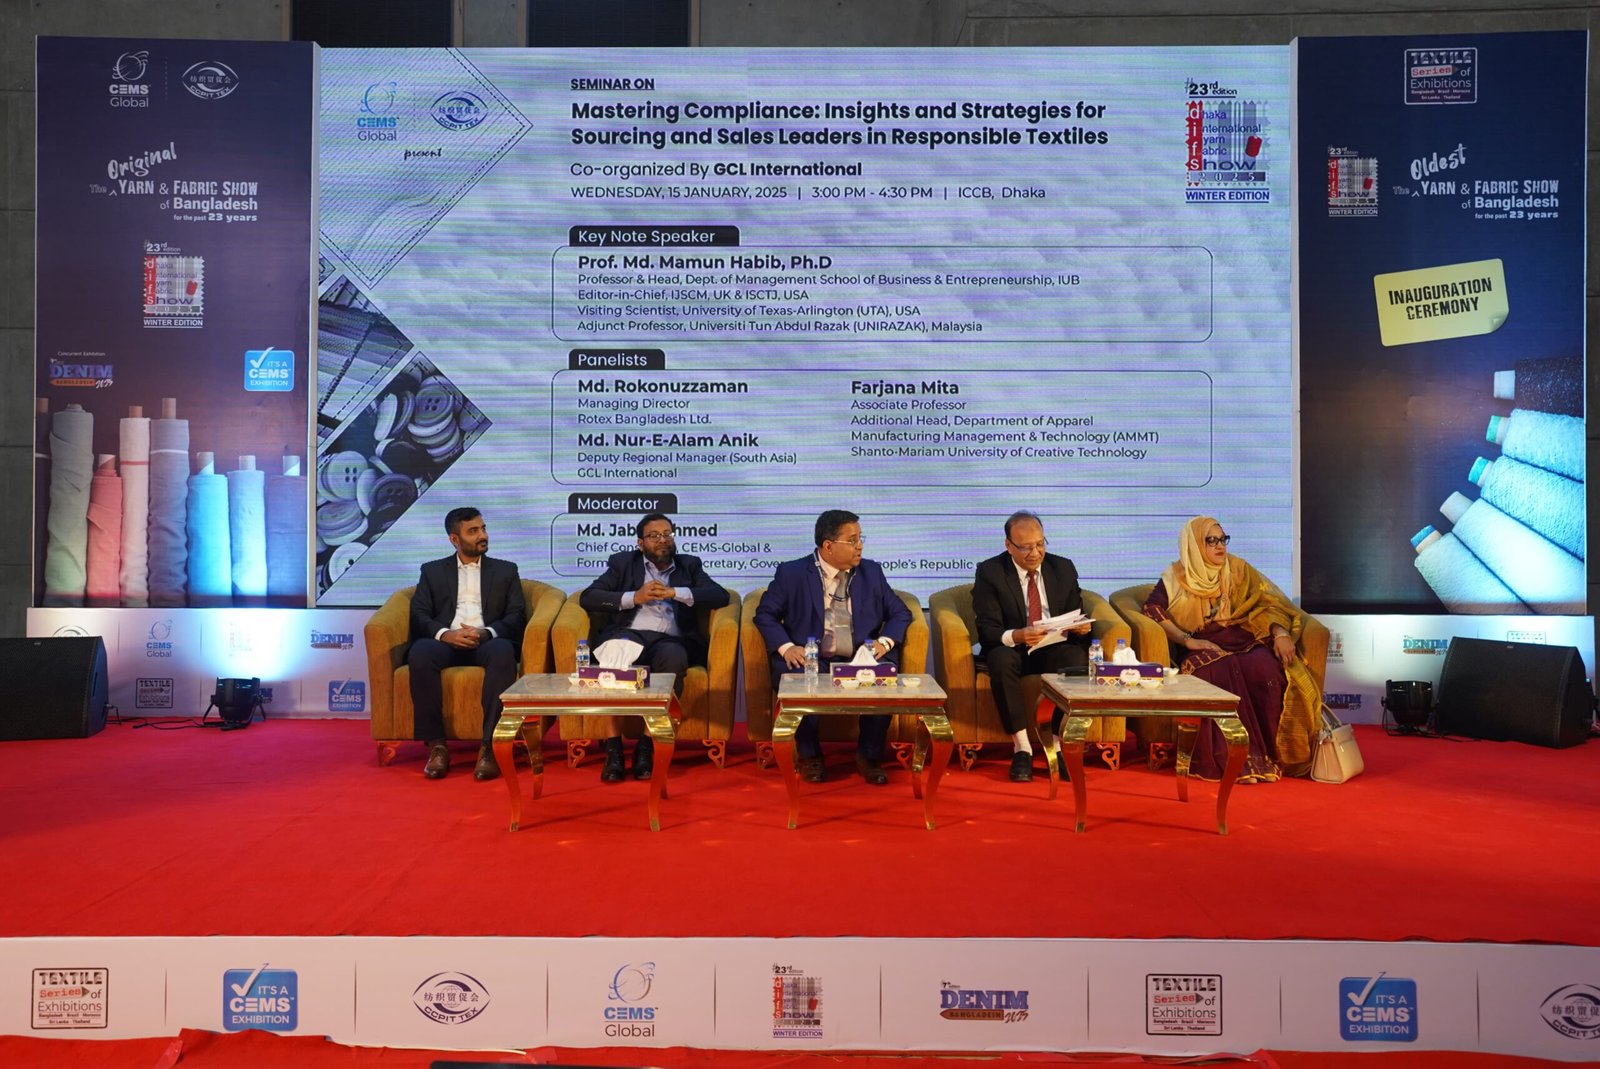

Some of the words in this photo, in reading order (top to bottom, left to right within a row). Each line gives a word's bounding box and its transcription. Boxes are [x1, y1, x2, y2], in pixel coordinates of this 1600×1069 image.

[1410, 51, 1472, 64] TEXTILE
[1412, 67, 1451, 76] Series
[1460, 67, 1471, 76] of
[109, 84, 149, 95] CEMS
[570, 78, 631, 90] SEMINAR
[634, 78, 655, 90] ON
[1410, 78, 1472, 89] Exhibitions
[215, 87, 232, 98] TEX
[110, 97, 149, 107] Global
[572, 100, 679, 123] Mastering
[684, 100, 820, 123] Compliance:
[825, 100, 910, 123] Insights
[915, 101, 957, 118] and
[961, 100, 1071, 123] Strategies
[1076, 101, 1106, 118] for
[357, 117, 397, 127] CEMS
[358, 130, 397, 141] Global
[571, 126, 666, 149] Sourcing
[670, 127, 712, 144] and
[717, 127, 774, 144] Sales
[779, 127, 862, 144] Leaders
[867, 126, 886, 144] in
[892, 126, 1021, 149] Responsible
[1026, 126, 1108, 144] Textiles
[107, 142, 177, 179] Original
[404, 148, 442, 160] present
[1410, 143, 1467, 180] Oldest
[570, 162, 685, 179] Co-organized
[690, 162, 709, 179] By
[714, 163, 747, 176] GCL
[751, 161, 861, 176] International
[119, 179, 154, 195] YARN
[159, 184, 169, 195] &
[173, 180, 218, 196] FABRIC
[223, 181, 258, 196] SHOW
[571, 187, 665, 199] WEDNESDAY,
[668, 187, 681, 198] 15
[683, 187, 751, 199] JANUARY,
[755, 187, 787, 198] 2025
[812, 187, 840, 198] 3:00
[844, 187, 866, 198] PM
[878, 187, 907, 198] 4:30
[910, 187, 933, 198] PM
[958, 187, 994, 200] ICCB,
[1002, 187, 1046, 198] Dhaka
[1421, 181, 1455, 195] YARN
[1460, 184, 1470, 194] &
[1474, 180, 1518, 194] FABRIC
[1523, 180, 1559, 194] SHOW
[1186, 191, 1226, 200] WINTER
[1228, 191, 1270, 200] EDITION
[160, 200, 170, 210] of
[173, 197, 258, 213] Bangladesh
[1461, 199, 1471, 209] of
[1475, 195, 1559, 210] Bangladesh
[193, 214, 207, 223] past
[208, 213, 223, 221] 23
[226, 214, 257, 223] years
[1509, 210, 1524, 219] 23
[1527, 211, 1559, 220] years
[578, 230, 606, 246] Key
[611, 230, 647, 243] Note
[651, 230, 715, 246] Speaker
[578, 255, 617, 269] Prof.
[623, 255, 654, 269] Md.
[660, 255, 725, 269] Mamun
[730, 255, 786, 271] Habib,
[791, 255, 832, 269] Ph.D
[578, 274, 633, 284] Professor
[636, 274, 645, 285] &
[648, 274, 682, 286] Head,
[686, 274, 718, 287] Dept.
[720, 274, 733, 284] of
[736, 275, 816, 287] Management
[820, 274, 860, 285] School
[863, 274, 876, 285] of
[878, 274, 931, 285] Business
[934, 275, 943, 285] &
[946, 274, 1055, 287] Entrepreneurship,
[1058, 275, 1080, 285] IUB
[578, 289, 669, 301] Editor-in-Chief,
[671, 289, 710, 302] IJSCM,
[713, 290, 731, 300] UK
[734, 290, 743, 300] &
[746, 289, 780, 301] ISCTJ,
[784, 290, 809, 300] USA
[1388, 277, 1492, 305] INAUGURATION
[1406, 297, 1479, 320] CEREMONY
[578, 354, 648, 367] Panelists
[50, 364, 113, 379] DENIM
[249, 368, 289, 379] CEMS
[578, 379, 609, 393] Md.
[614, 379, 748, 393] Rokonuzzaman
[851, 380, 915, 397] Farjana
[921, 380, 959, 395] Mita
[578, 398, 638, 411] Managing
[643, 398, 690, 409] Director
[578, 433, 609, 447] Md.
[614, 433, 714, 447] Nur-E-Alam
[719, 433, 759, 447] Anik
[578, 497, 659, 510] Moderator
[577, 523, 604, 537] Md.
[576, 542, 608, 553] Chief
[682, 541, 760, 553] CEMS-Global
[763, 542, 772, 553] &
[920, 559, 973, 572] Republic
[310, 633, 354, 644] DENIM
[1403, 639, 1448, 649] DENIM
[332, 694, 361, 702] CEMS
[39, 972, 102, 985] TEXTILE
[1152, 977, 1216, 991] TEXTILE
[40, 988, 81, 998] Series
[90, 989, 102, 999] of
[258, 986, 278, 995] IT'S
[279, 986, 288, 995] A
[38, 1000, 102, 1012] Exhibitions
[230, 998, 291, 1013] CEMS
[940, 990, 1029, 1009] DENIM
[1154, 994, 1195, 1004] Series
[1204, 996, 1216, 1006] of
[1375, 994, 1396, 1005] IT'S
[1398, 994, 1407, 1005] A
[424, 1006, 457, 1022] CCPIT
[459, 1007, 478, 1021] TEX
[604, 1007, 655, 1020] CEMS
[1152, 1007, 1216, 1018] Exhibitions
[1346, 1008, 1410, 1022] CEMS
[232, 1015, 290, 1024] EXHIBITION
[605, 1023, 655, 1037] Global
[1349, 1025, 1409, 1034] EXHIBITION
